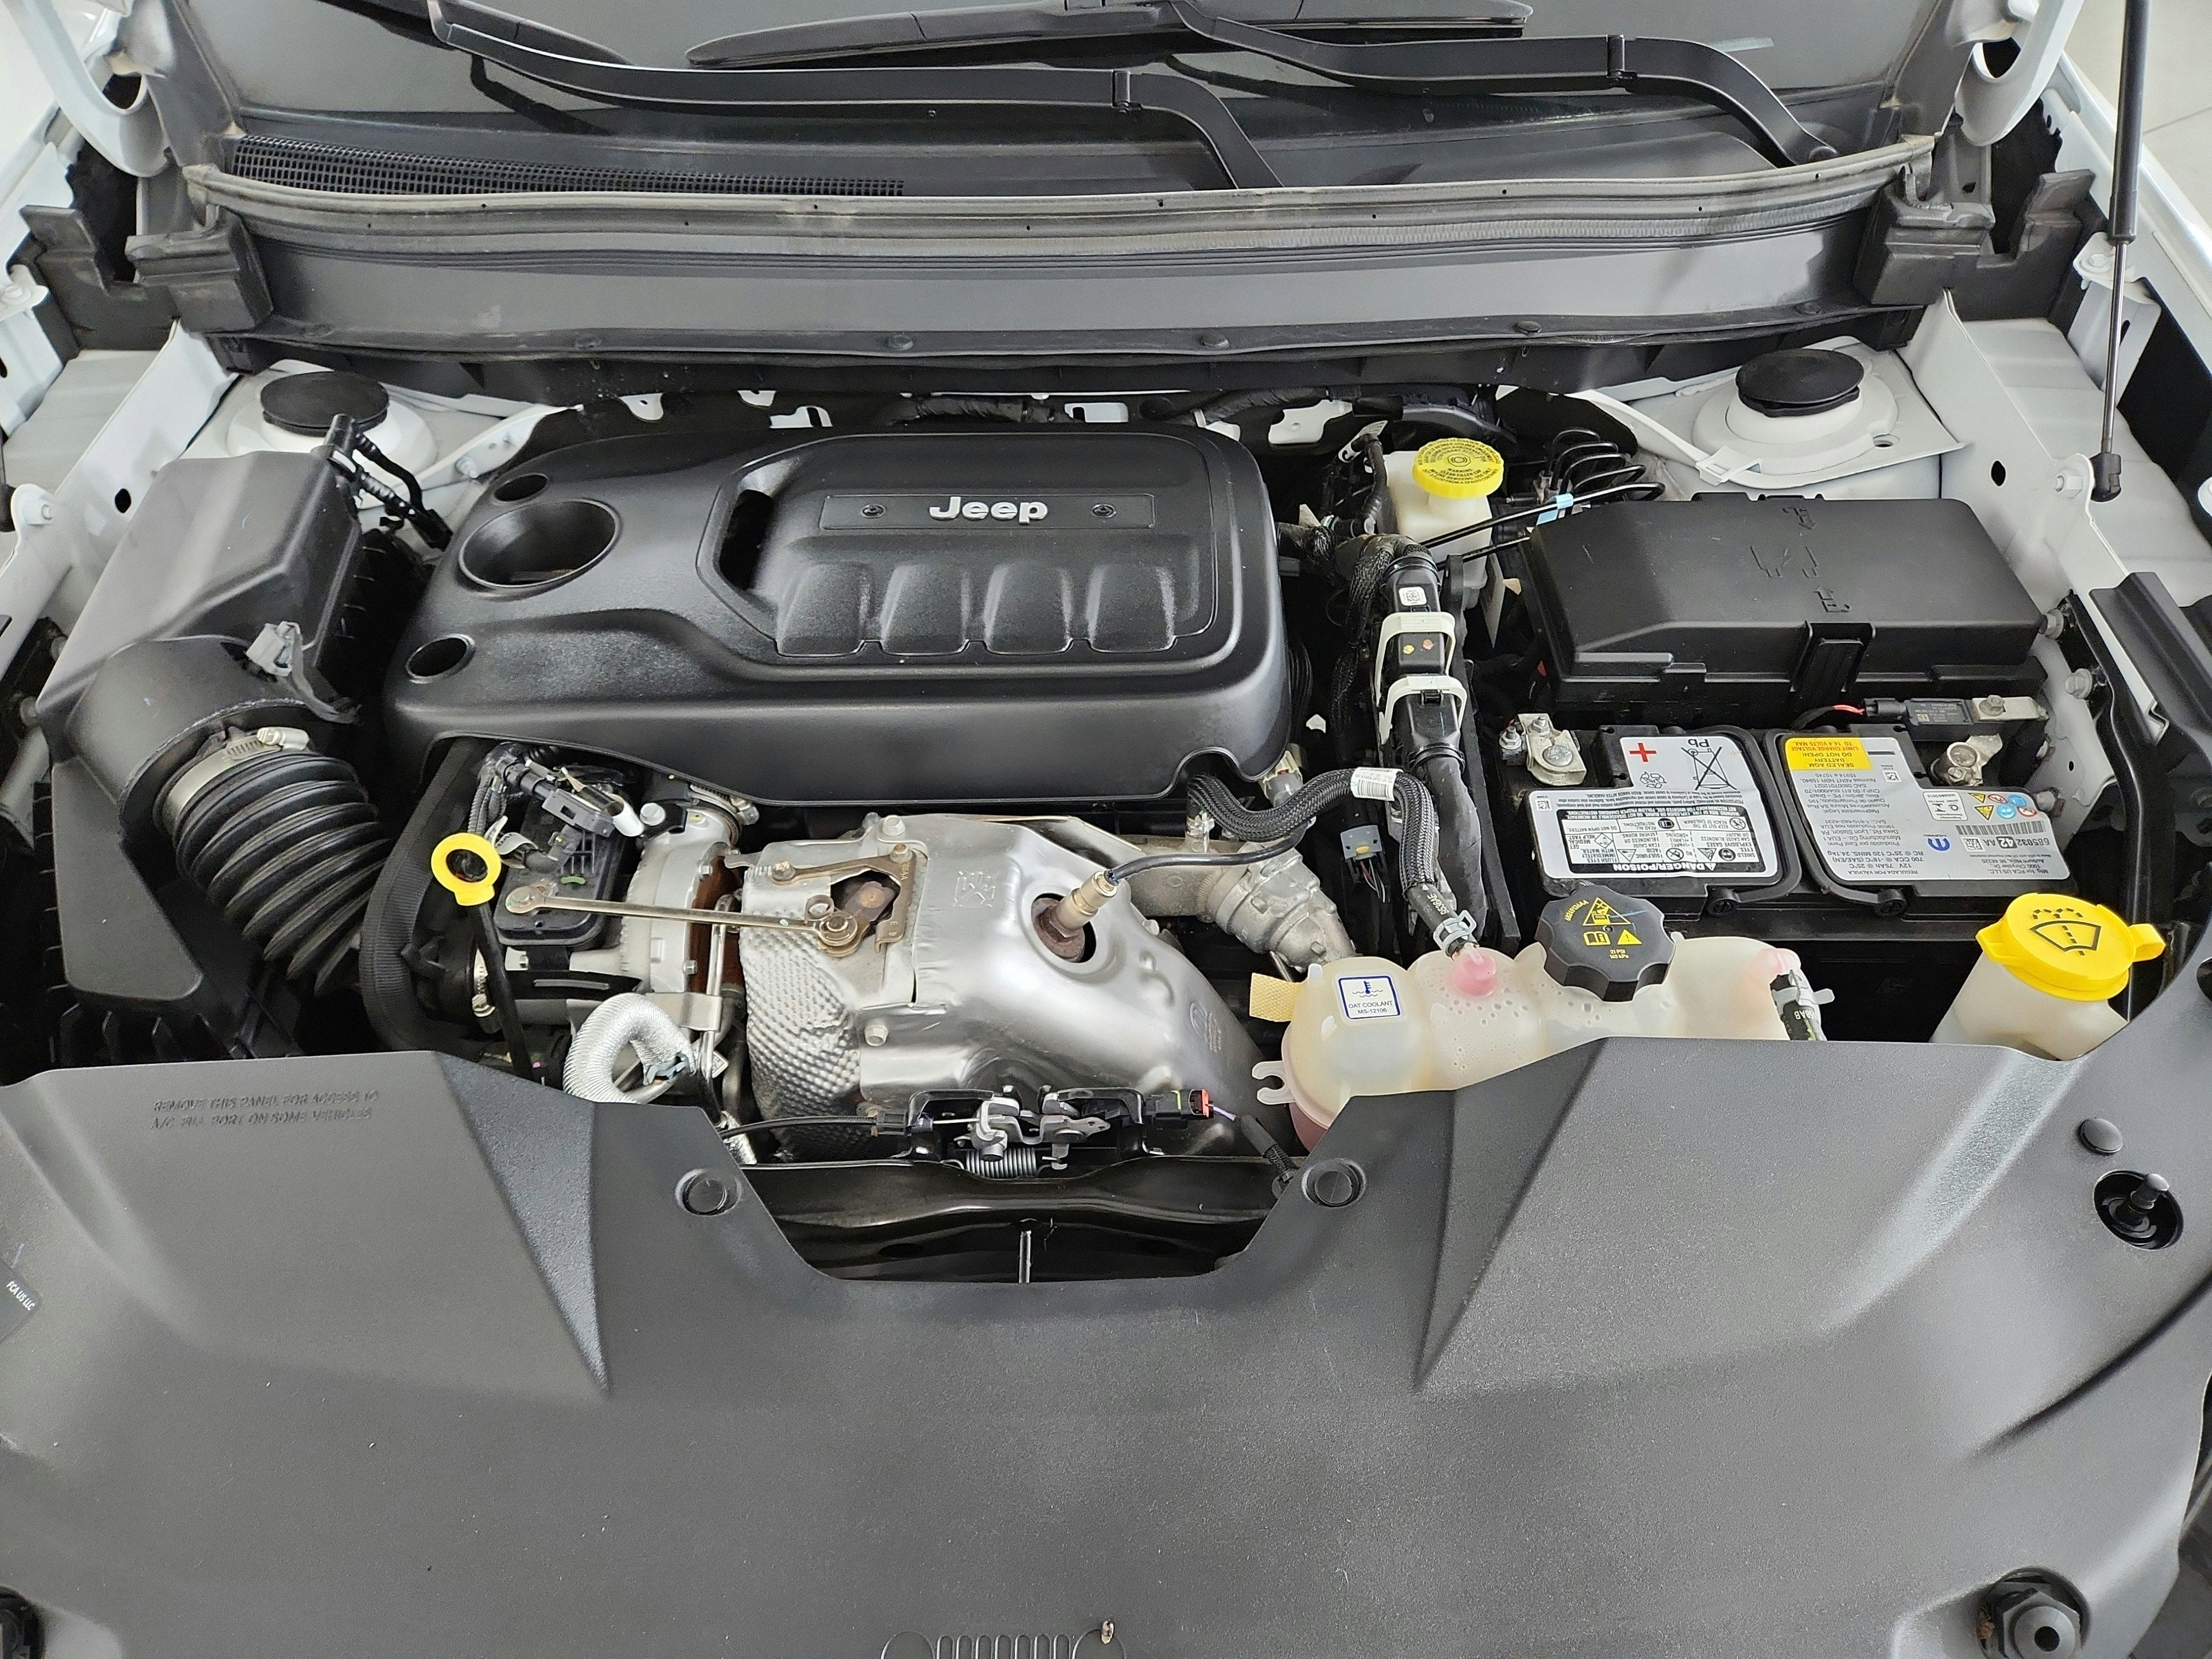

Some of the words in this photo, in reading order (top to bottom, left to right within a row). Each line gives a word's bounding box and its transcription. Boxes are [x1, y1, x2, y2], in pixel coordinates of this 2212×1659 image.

[929, 496, 1048, 524] Jeep
[1688, 738, 1709, 748] Pb
[1997, 838, 2013, 847] 42
[1612, 862, 1706, 871] DANGER/POISON
[7, 1280, 20, 1295] FCA
[16, 1290, 27, 1302] US
[22, 1298, 35, 1311] LLC
